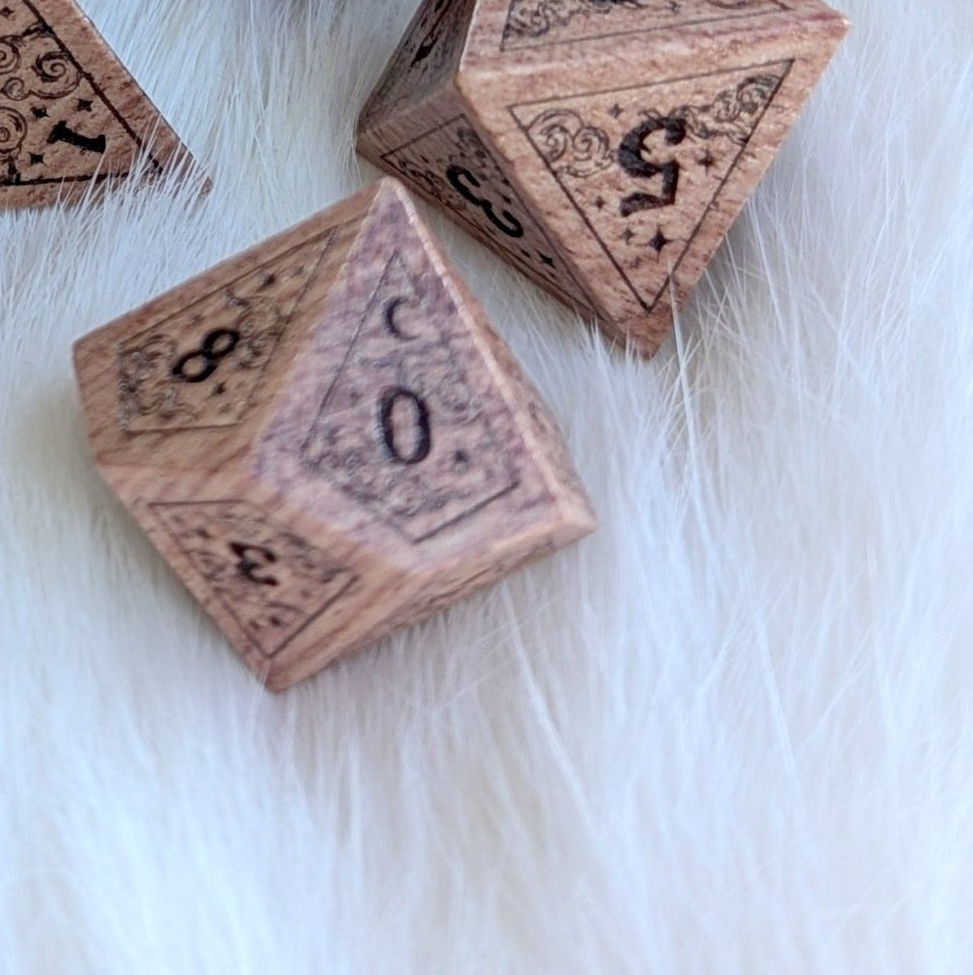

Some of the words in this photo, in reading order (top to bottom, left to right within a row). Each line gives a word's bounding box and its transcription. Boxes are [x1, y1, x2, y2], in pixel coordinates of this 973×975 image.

[47, 120, 107, 155] 1
[618, 115, 688, 218] 5
[445, 164, 525, 239] 3
[171, 328, 239, 383] 8
[378, 387, 433, 466] 0
[228, 540, 281, 587] 3
